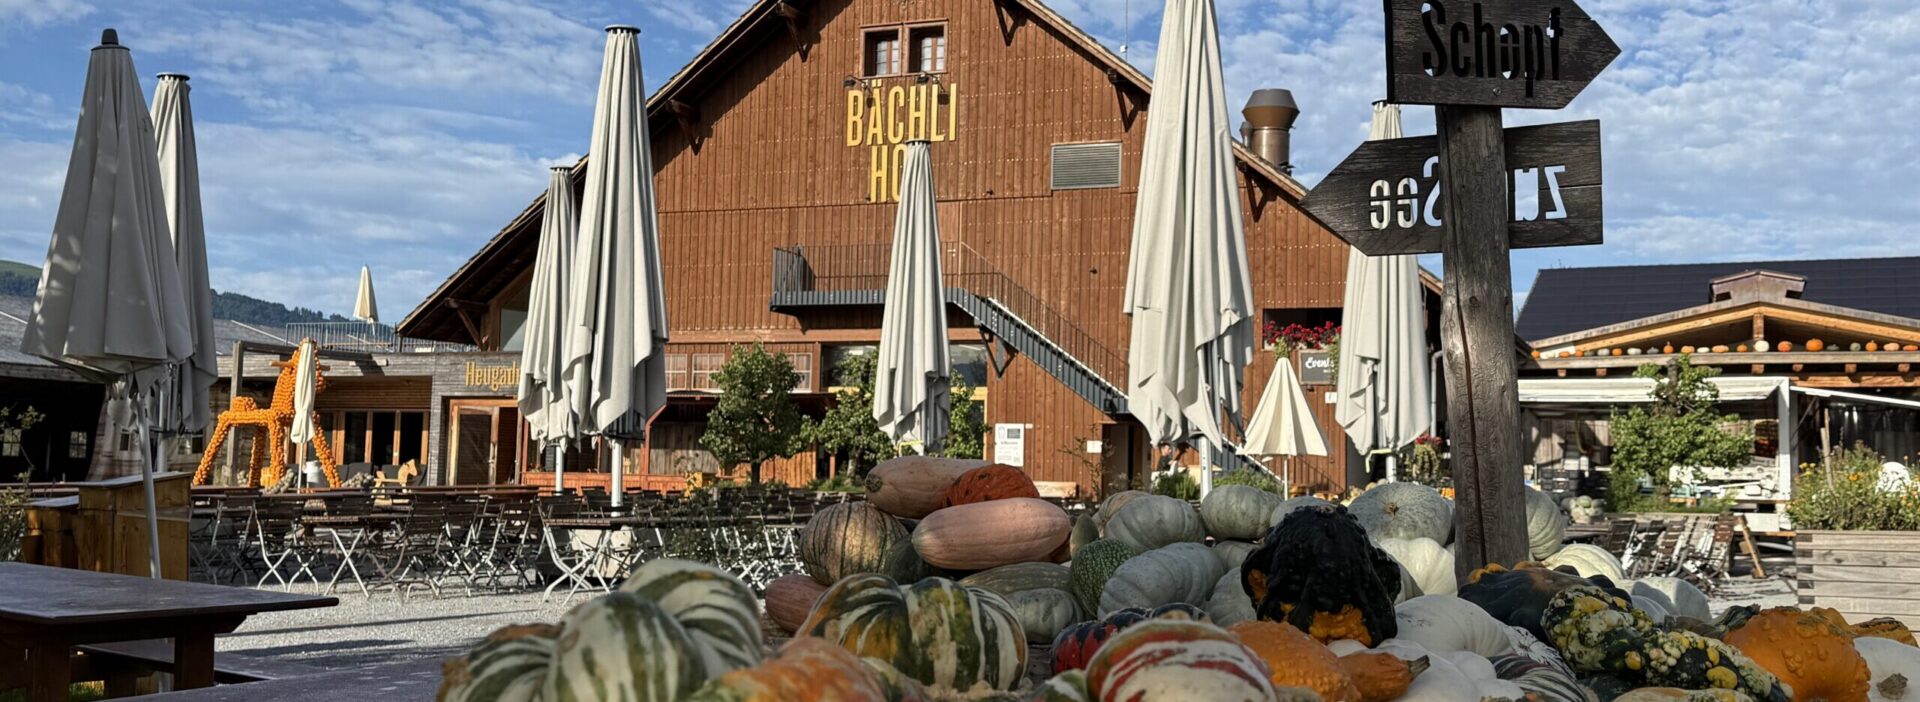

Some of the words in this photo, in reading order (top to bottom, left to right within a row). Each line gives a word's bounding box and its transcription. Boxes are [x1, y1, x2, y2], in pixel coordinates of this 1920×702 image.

[1421, 2, 1563, 98] Schopf
[846, 79, 957, 147] BÄCHLI
[870, 143, 908, 203] HO
